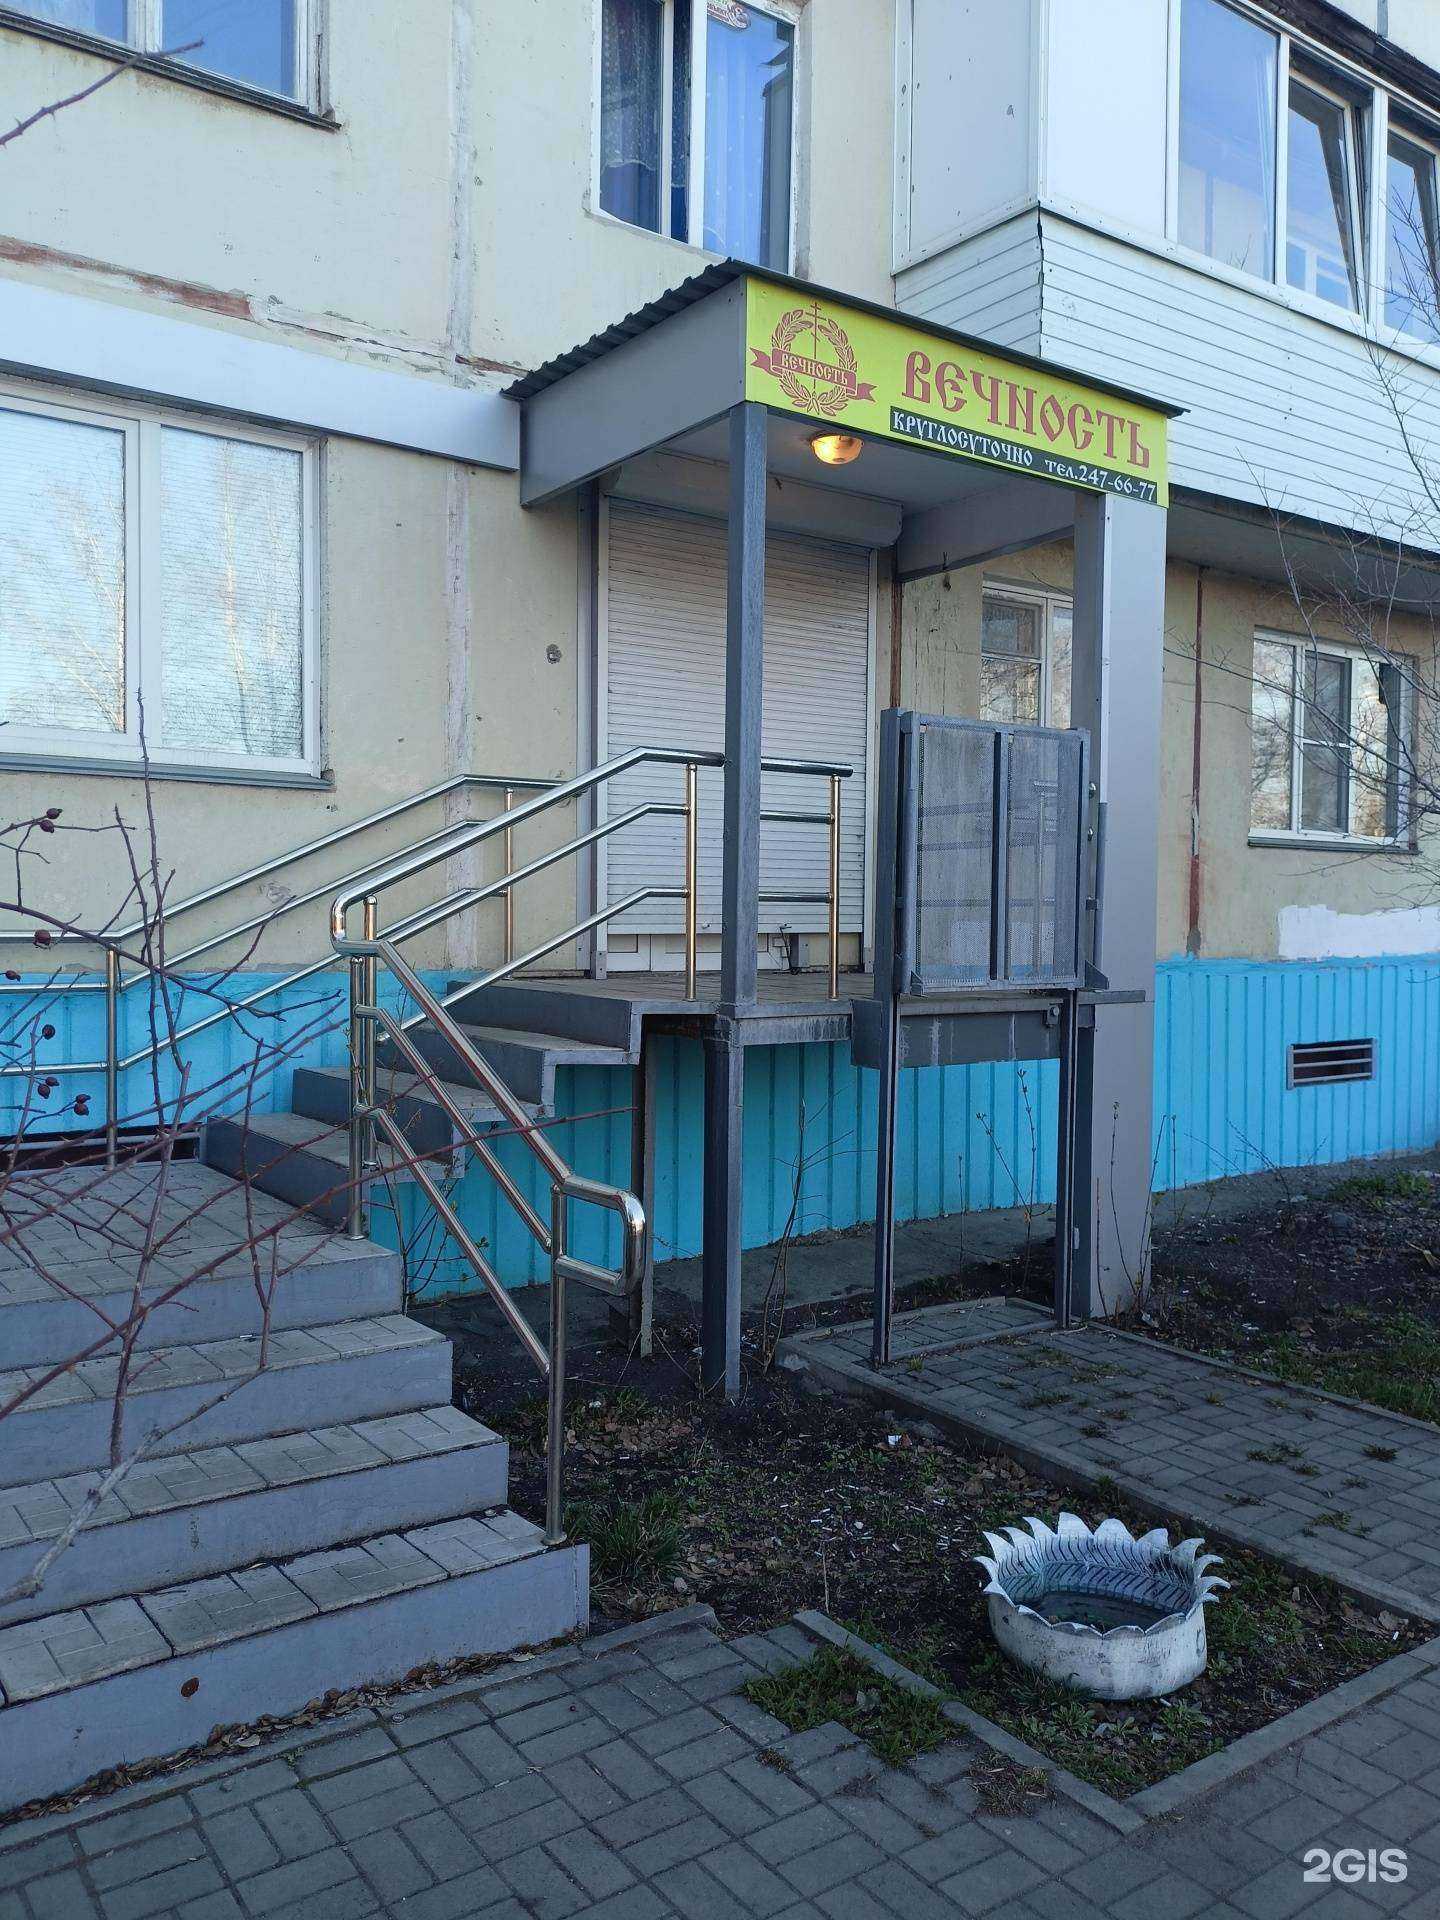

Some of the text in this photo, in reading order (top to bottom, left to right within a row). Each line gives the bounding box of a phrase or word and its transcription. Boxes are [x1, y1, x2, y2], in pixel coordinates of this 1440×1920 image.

[782, 353, 847, 385] ВЕЧНОСТЬ
[902, 351, 1149, 468] ВЕЧНОСТЬ
[893, 411, 1033, 466] КРУГЛОСУТОЧНО
